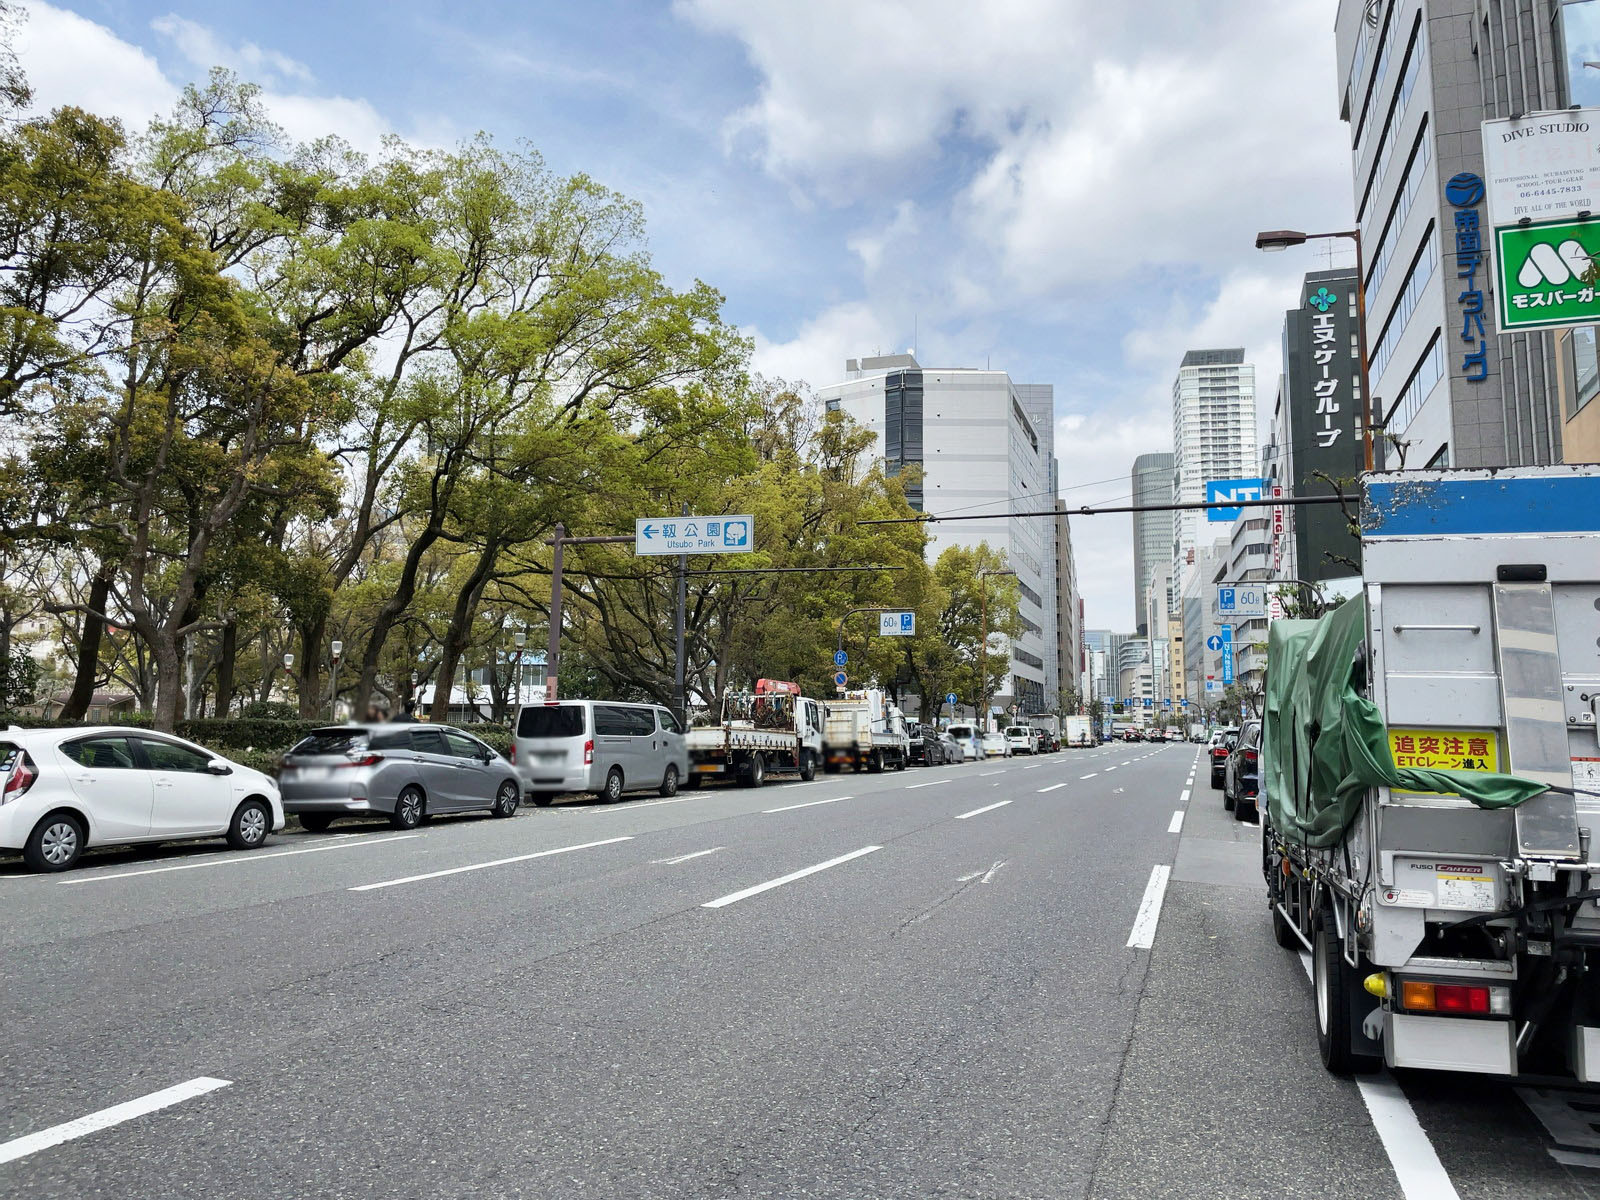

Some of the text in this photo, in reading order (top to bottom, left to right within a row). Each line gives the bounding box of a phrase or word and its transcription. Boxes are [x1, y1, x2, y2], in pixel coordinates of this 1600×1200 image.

[1502, 122, 1590, 143] DIVE STUDIO
[1520, 185, 1582, 198] 06-6445-7833
[1514, 206, 1529, 215] DIVE
[1555, 201, 1568, 209] THE
[1569, 198, 1592, 207] WORLD
[1454, 209, 1488, 381] 帝国データバンク
[1312, 313, 1342, 447] エヌ・ケーグループ
[667, 539, 715, 549] Utsubo Park
[1224, 590, 1232, 602] P
[903, 615, 910, 625] P
[1395, 735, 1490, 757] 追突注意
[1397, 756, 1489, 770] ETCレーン進入
